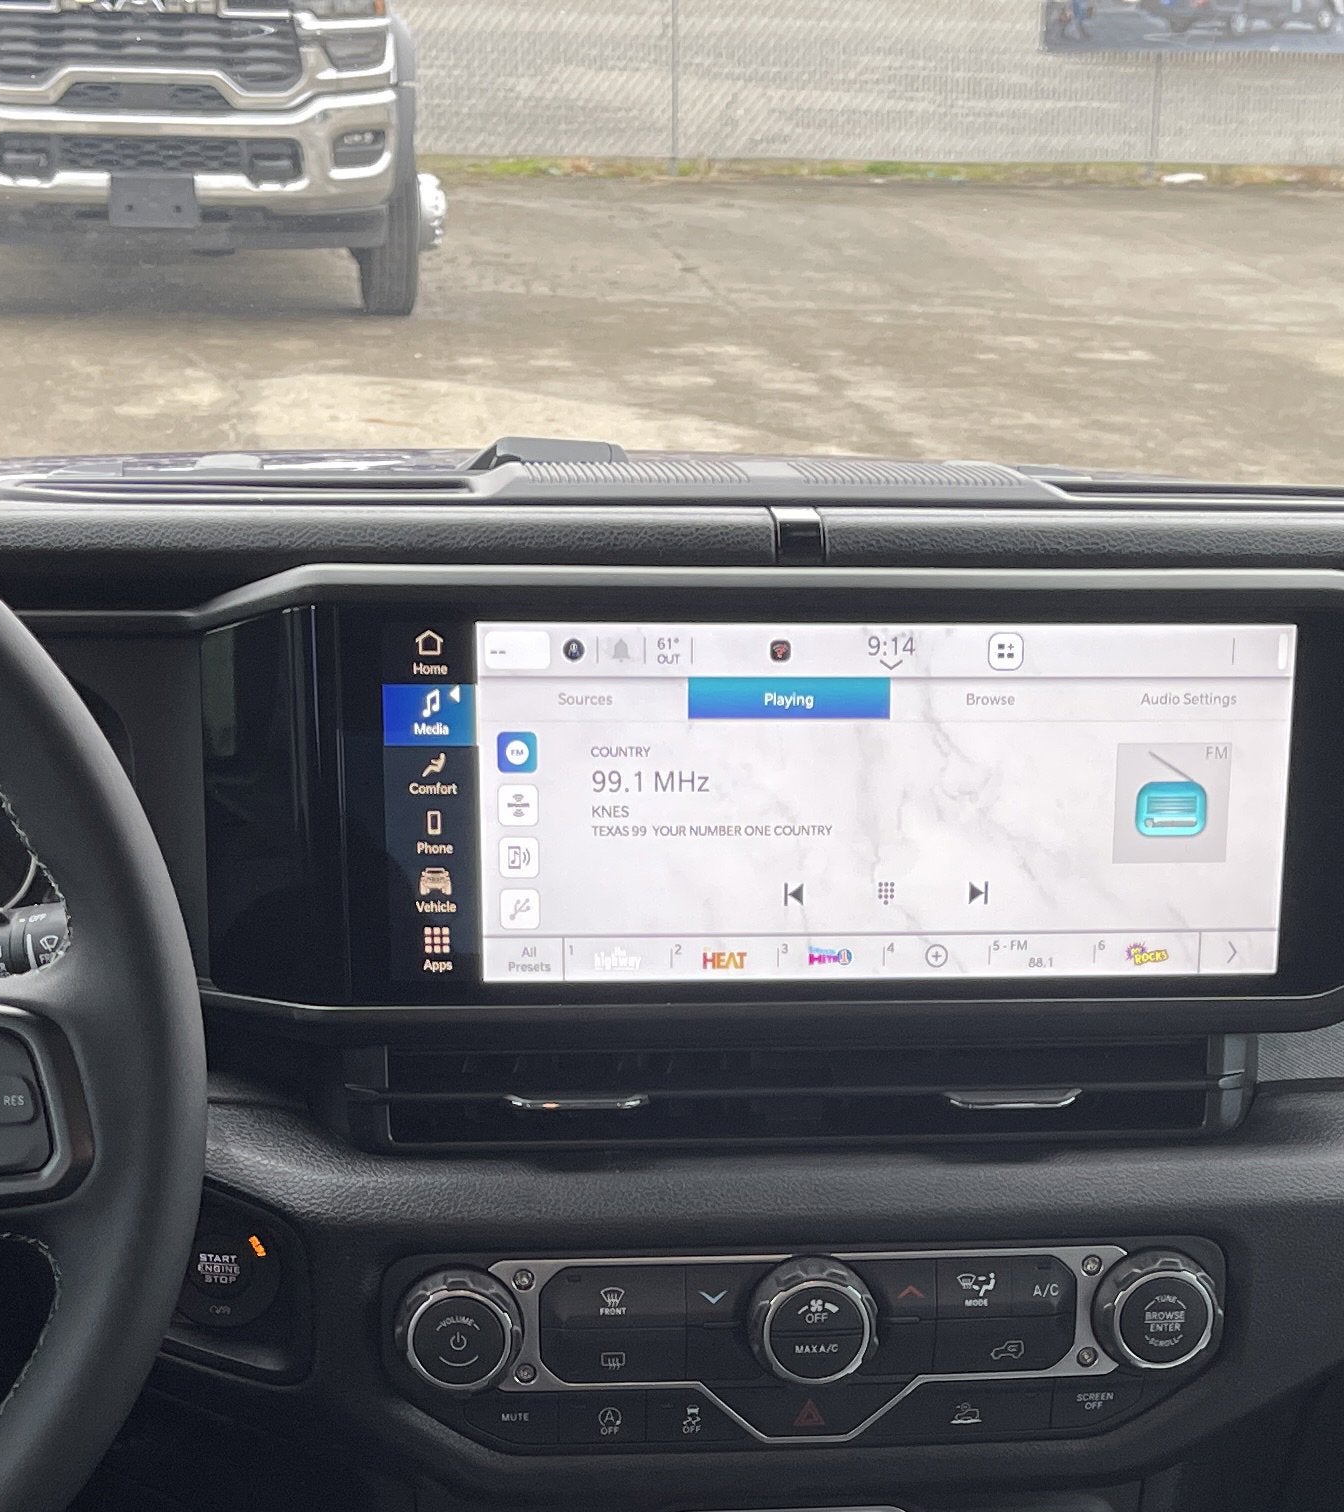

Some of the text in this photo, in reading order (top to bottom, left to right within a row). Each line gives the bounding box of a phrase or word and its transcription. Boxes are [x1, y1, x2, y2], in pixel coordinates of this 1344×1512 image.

[867, 636, 916, 658] 9:14
[657, 653, 681, 666] OUT
[413, 663, 448, 675] Home
[557, 692, 613, 707] Sources
[764, 692, 815, 709] Playing
[965, 692, 1016, 707] Browse
[1141, 692, 1237, 708] Audio Settings
[413, 722, 449, 736] Media
[590, 746, 651, 759] COUNTRY
[1206, 746, 1228, 760] FM
[591, 771, 710, 794] 99.1 MHz
[409, 782, 457, 796] Comfort
[591, 806, 630, 819] KNES
[591, 825, 833, 838] TEXAS 99 YOUR NUMBER ONE COUNTRY
[416, 842, 453, 856] Phone
[416, 900, 456, 914] Vehicle
[674, 944, 682, 955] 2
[781, 944, 789, 954] 3
[887, 943, 895, 954] 4
[993, 940, 1027, 951] 5 FM
[1098, 940, 1106, 951] 6
[423, 960, 453, 974] Apps
[508, 961, 551, 973] Presets
[702, 952, 747, 970] HEAT
[1028, 957, 1054, 968] 88.1
[3, 1095, 25, 1107] RES
[199, 1253, 237, 1263] START
[198, 1264, 241, 1274] ENGINE
[204, 1275, 237, 1284] STOP
[1033, 1281, 1059, 1298] A/C
[964, 1298, 989, 1308] MODE
[599, 1307, 627, 1316] FRONT
[1145, 1310, 1185, 1320] BROWSE
[440, 1315, 475, 1330] VOLUME
[805, 1312, 829, 1324] OFF
[1149, 1322, 1181, 1332] ENTER
[1076, 1391, 1114, 1402] SCREEN
[1084, 1401, 1103, 1410] OFF
[501, 1412, 529, 1422] MUTE
[600, 1426, 619, 1435] OFF
[682, 1424, 701, 1434] OFF
